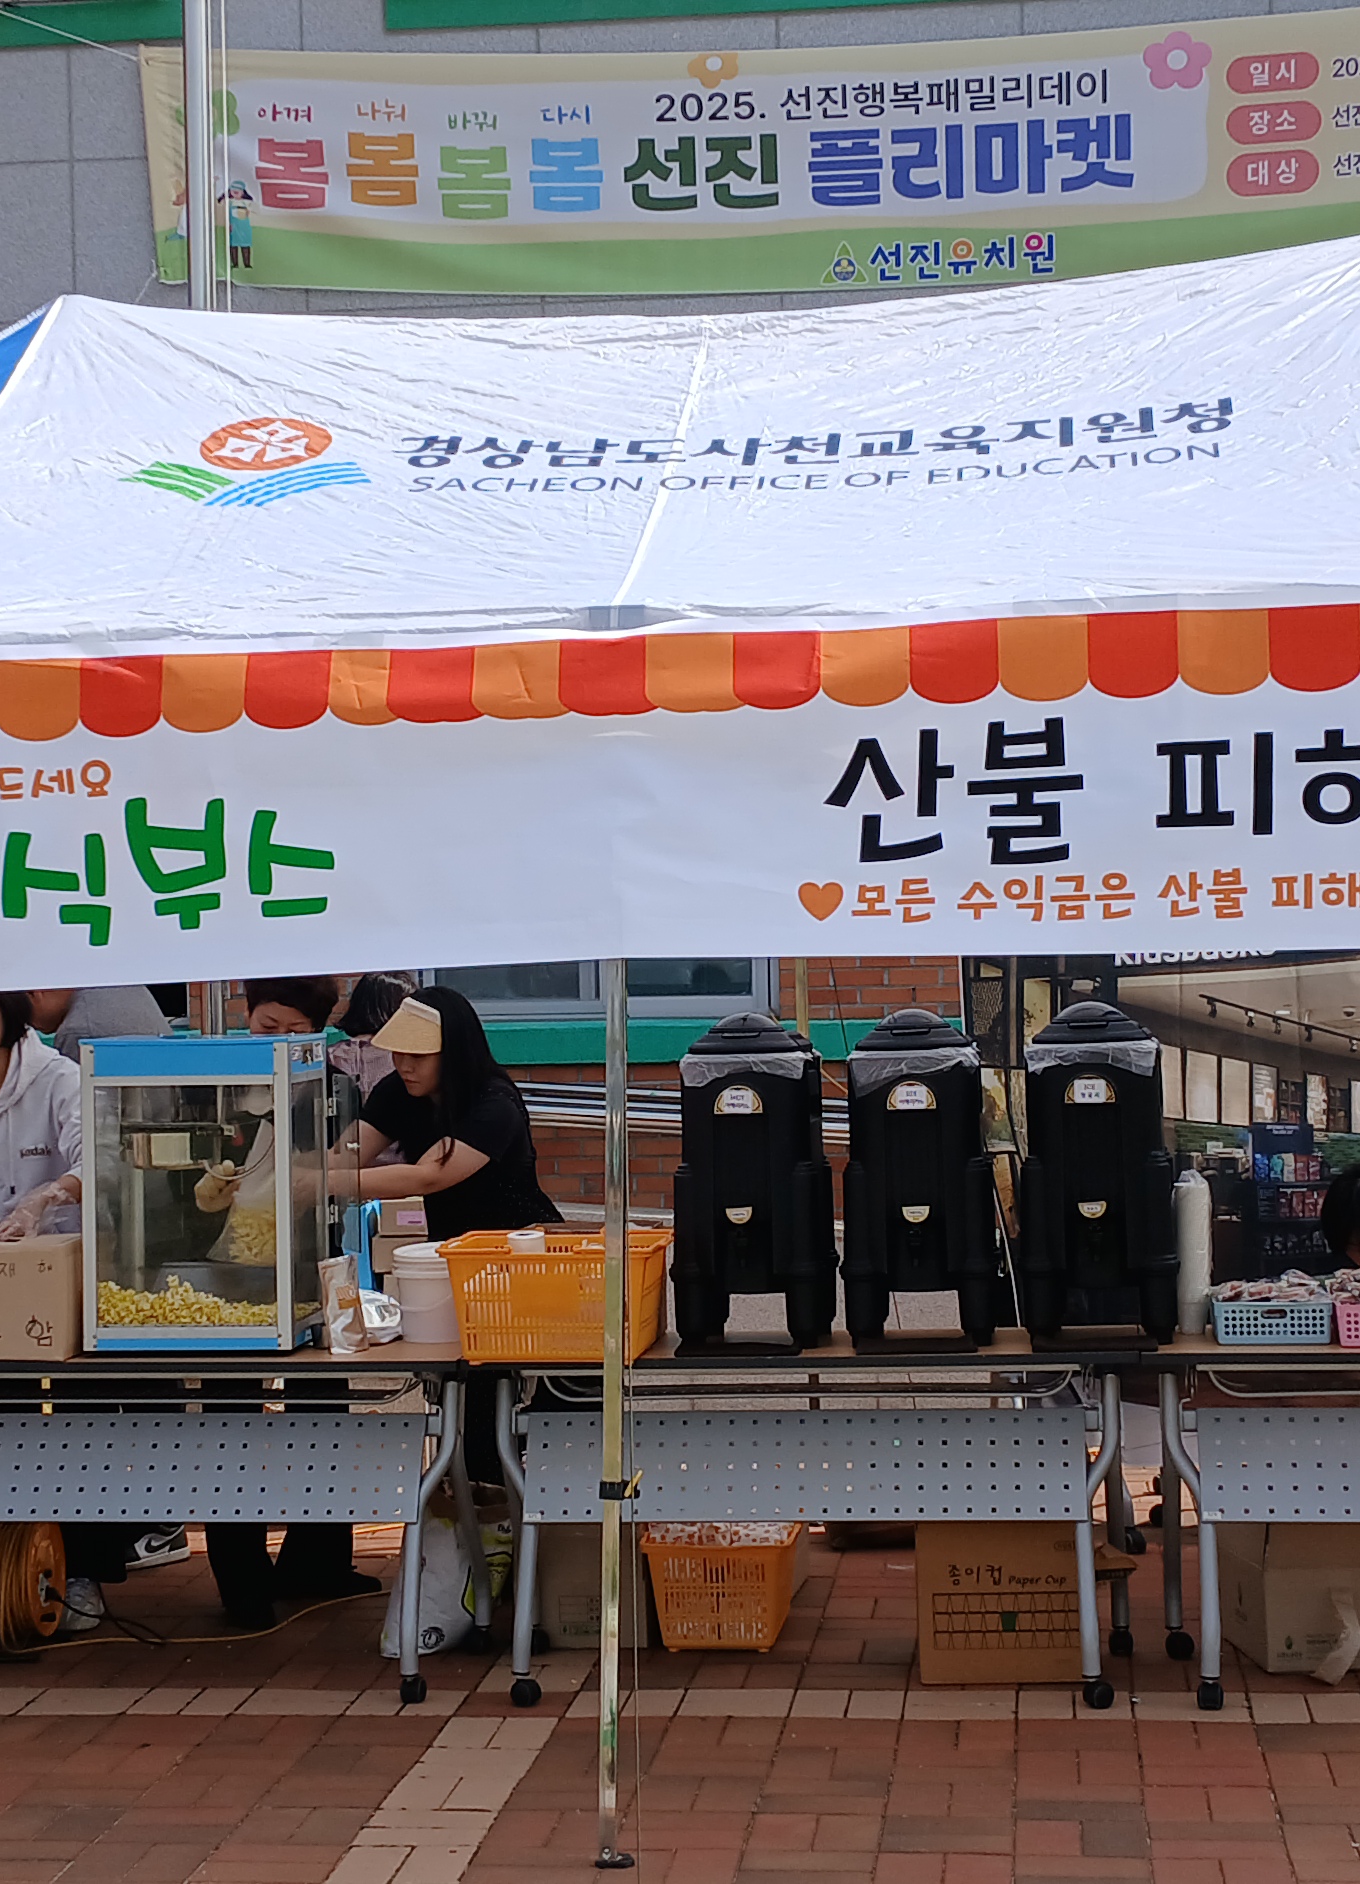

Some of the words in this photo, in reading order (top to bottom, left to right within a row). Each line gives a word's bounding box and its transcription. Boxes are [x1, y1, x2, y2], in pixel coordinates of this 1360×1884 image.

[1249, 58, 1296, 87] 일시
[655, 91, 768, 122] 2025.
[780, 68, 1109, 122] 선진행복패밀리데이
[257, 103, 312, 123] 아껴
[357, 99, 406, 121] 나눠
[447, 110, 497, 131] 바꿔
[540, 104, 591, 125] 다시
[1248, 110, 1297, 135] 장소
[623, 133, 780, 212] 선진
[807, 113, 1135, 207] 플리마켓
[1247, 158, 1298, 186] 대상
[868, 232, 1056, 282] 선진유치원
[409, 475, 642, 493] SACHEON
[660, 474, 828, 491] OFFICE
[845, 469, 911, 488] OF
[928, 443, 1220, 485] EDUCATION
[823, 716, 1084, 866] 산불
[851, 878, 936, 923] 모든
[956, 872, 1136, 922] 수익금은
[1157, 868, 1248, 919] 산불
[948, 1564, 1002, 1585] 종이컵
[1009, 1574, 1041, 1588] Paper
[1045, 1574, 1067, 1587] Cup
